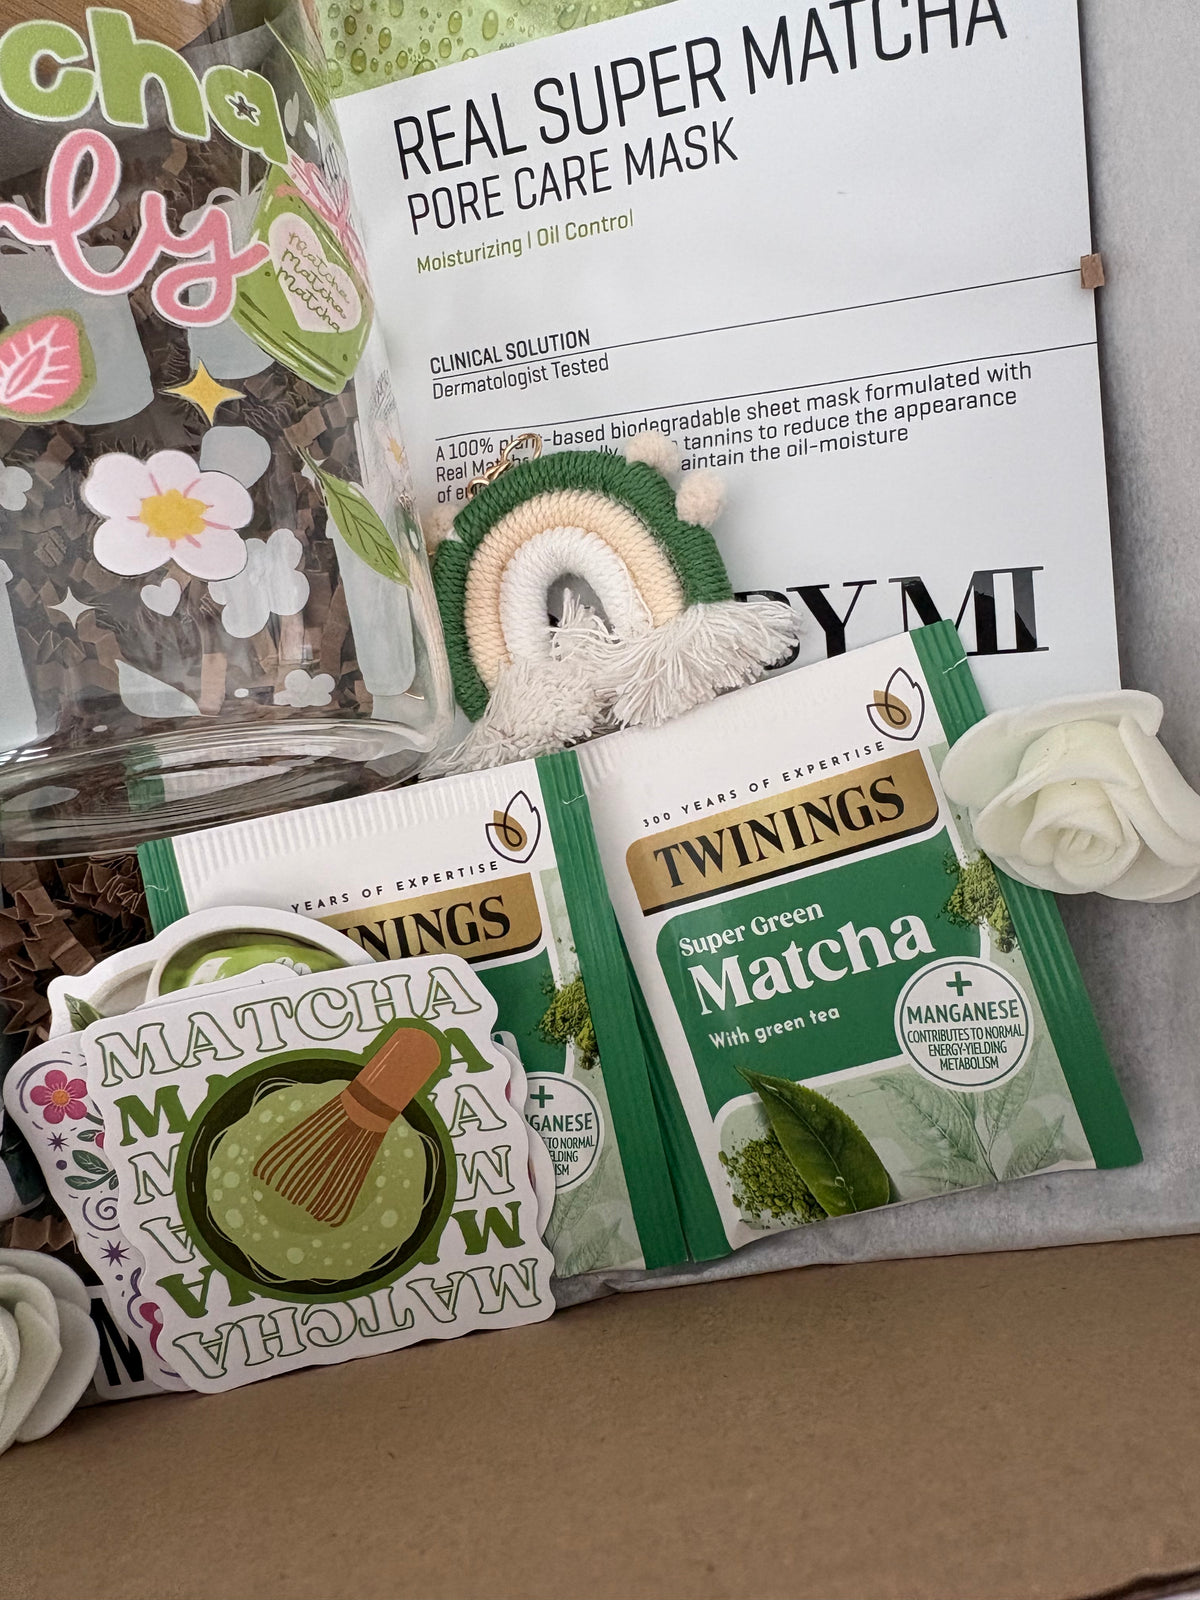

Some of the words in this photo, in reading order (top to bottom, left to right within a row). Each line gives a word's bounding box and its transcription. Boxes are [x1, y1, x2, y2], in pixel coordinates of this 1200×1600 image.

[393, 92, 527, 180] REAL
[533, 36, 726, 145] SUPER
[742, 0, 1007, 95] MATCHA
[407, 174, 505, 235] PORE
[514, 148, 612, 210] CARE
[624, 117, 738, 185] MASK
[0, 128, 270, 328] ly
[416, 231, 523, 274] Moisturizing
[536, 225, 560, 248] Oil
[565, 208, 634, 242] Control
[430, 345, 503, 375] CLINICAL
[505, 328, 591, 361] SOLUTION
[432, 365, 549, 400] Dermatologist
[551, 353, 609, 380] Tested
[435, 445, 445, 462] A
[449, 437, 494, 460] 100%
[611, 405, 741, 440] biodegradable
[746, 397, 801, 421] sheet
[806, 387, 860, 412] mask
[865, 367, 980, 402] formulated
[986, 360, 1032, 384] with
[684, 428, 753, 451] tannins
[758, 425, 777, 440] to
[783, 412, 850, 437] reduce
[855, 406, 888, 426] the
[893, 390, 1017, 421] appearance
[436, 461, 467, 483] Real
[681, 449, 744, 471] aintain
[750, 443, 781, 462] the
[786, 426, 909, 458] oil-moisture
[437, 485, 452, 504] of
[734, 566, 1049, 670] YMI
[643, 811, 671, 828] 300
[681, 789, 737, 815] YEARS
[749, 778, 770, 793] OF
[782, 741, 885, 782] EXPERTISE
[653, 775, 905, 889] TWININGS
[291, 893, 350, 913] YEARS
[361, 885, 384, 899] OF
[396, 860, 499, 891] EXPERTISE
[338, 894, 511, 961] NINGS
[679, 924, 746, 957] Super
[750, 903, 824, 936] Green
[688, 915, 937, 1016] Matcha
[95, 966, 482, 1087] MATCHA
[708, 1026, 750, 1049] With
[754, 1016, 806, 1044] green
[809, 1007, 841, 1024] tea
[906, 999, 1020, 1025] MANGANESE
[907, 1027, 970, 1044] CONTRIBUTES
[970, 1027, 984, 1040] TO
[985, 1023, 1025, 1039] NORMAL
[928, 1040, 1008, 1057] ENERGY-YIELDING
[939, 1055, 1000, 1071] METABOLISM
[526, 1111, 593, 1132] GANESE
[560, 1134, 596, 1150] NORMAL
[172, 1257, 542, 1379] MATCHA
